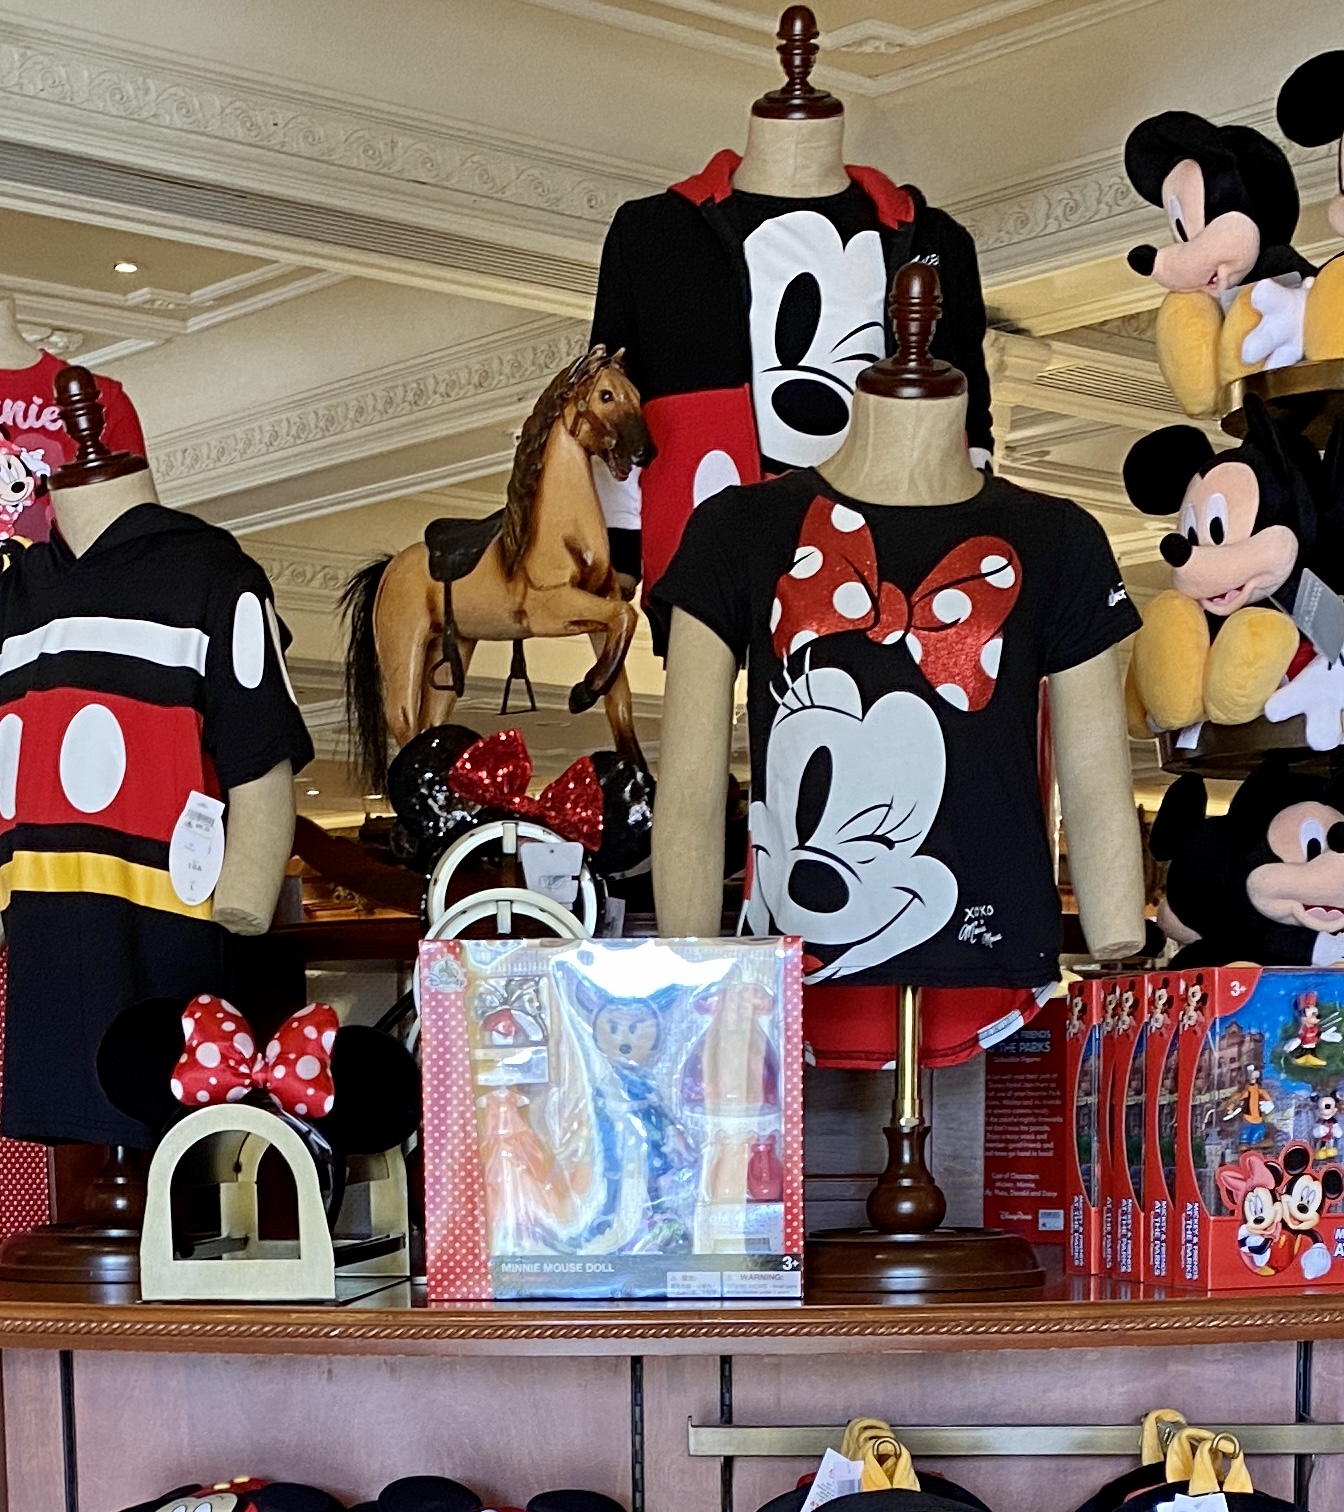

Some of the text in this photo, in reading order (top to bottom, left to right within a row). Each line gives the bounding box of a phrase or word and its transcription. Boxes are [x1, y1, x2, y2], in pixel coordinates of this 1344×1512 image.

[964, 905, 994, 921] XOXO
[1230, 980, 1247, 996] 3+
[1019, 1041, 1051, 1053] PARKS
[501, 1263, 615, 1273] MINNIE MOUSE DOLL
[782, 1255, 799, 1270] 3+
